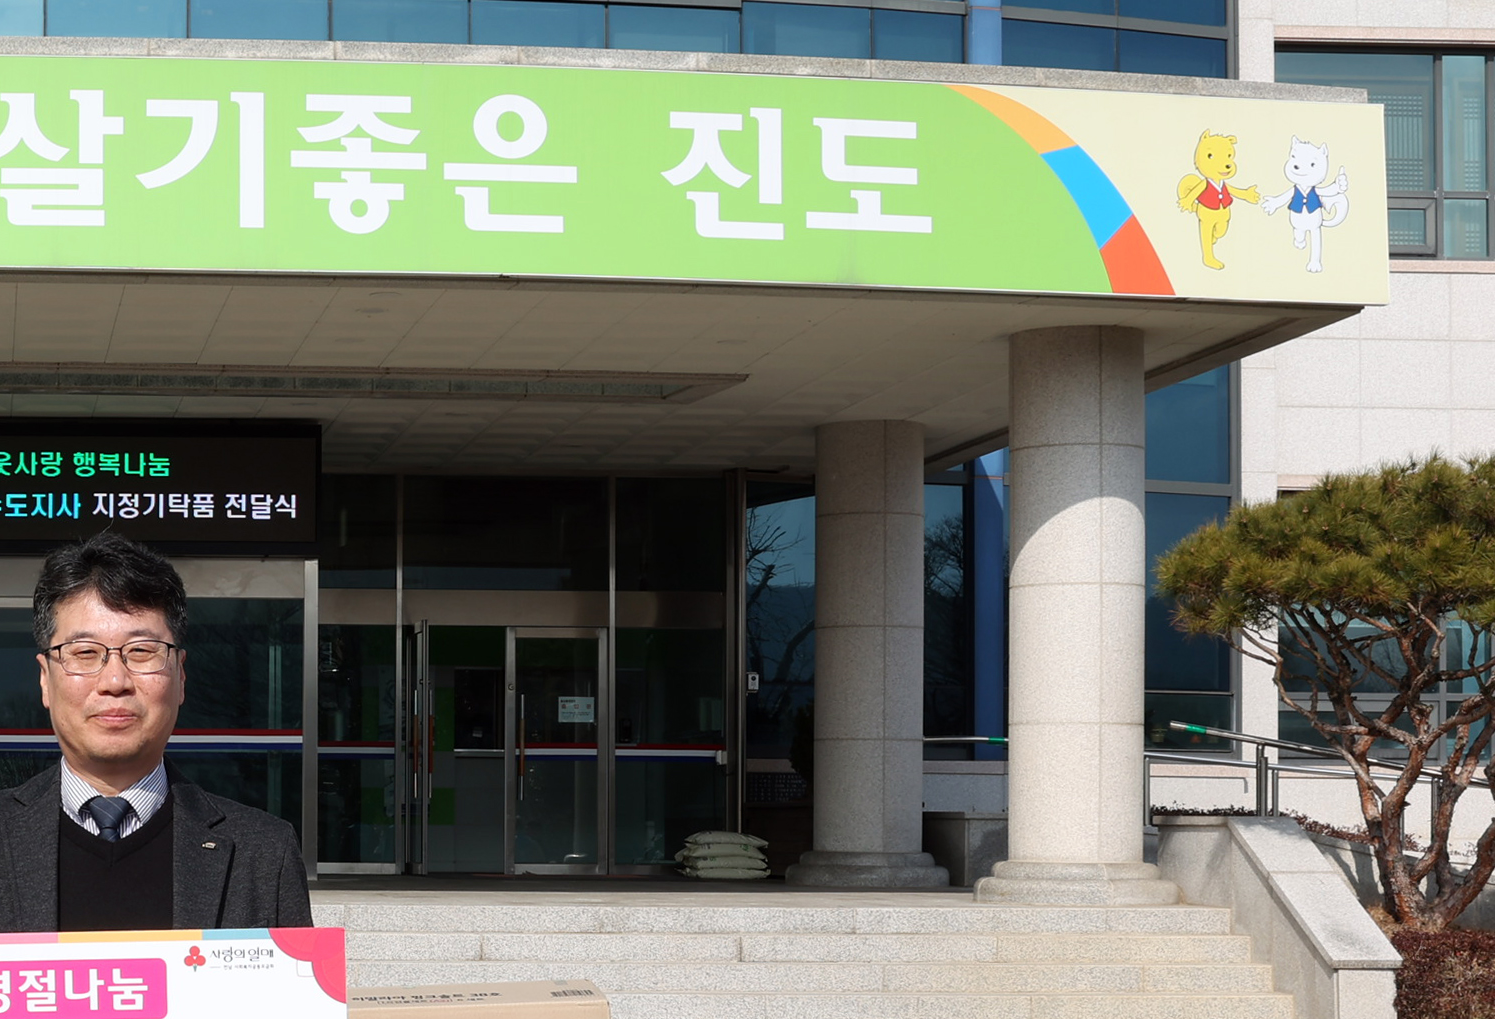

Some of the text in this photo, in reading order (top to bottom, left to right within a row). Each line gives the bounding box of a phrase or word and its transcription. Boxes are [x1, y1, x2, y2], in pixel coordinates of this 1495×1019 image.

[661, 106, 934, 241] 진도
[72, 449, 171, 478] 행복나눔
[91, 490, 215, 520] 지정기탁품
[224, 491, 298, 520] 전달식
